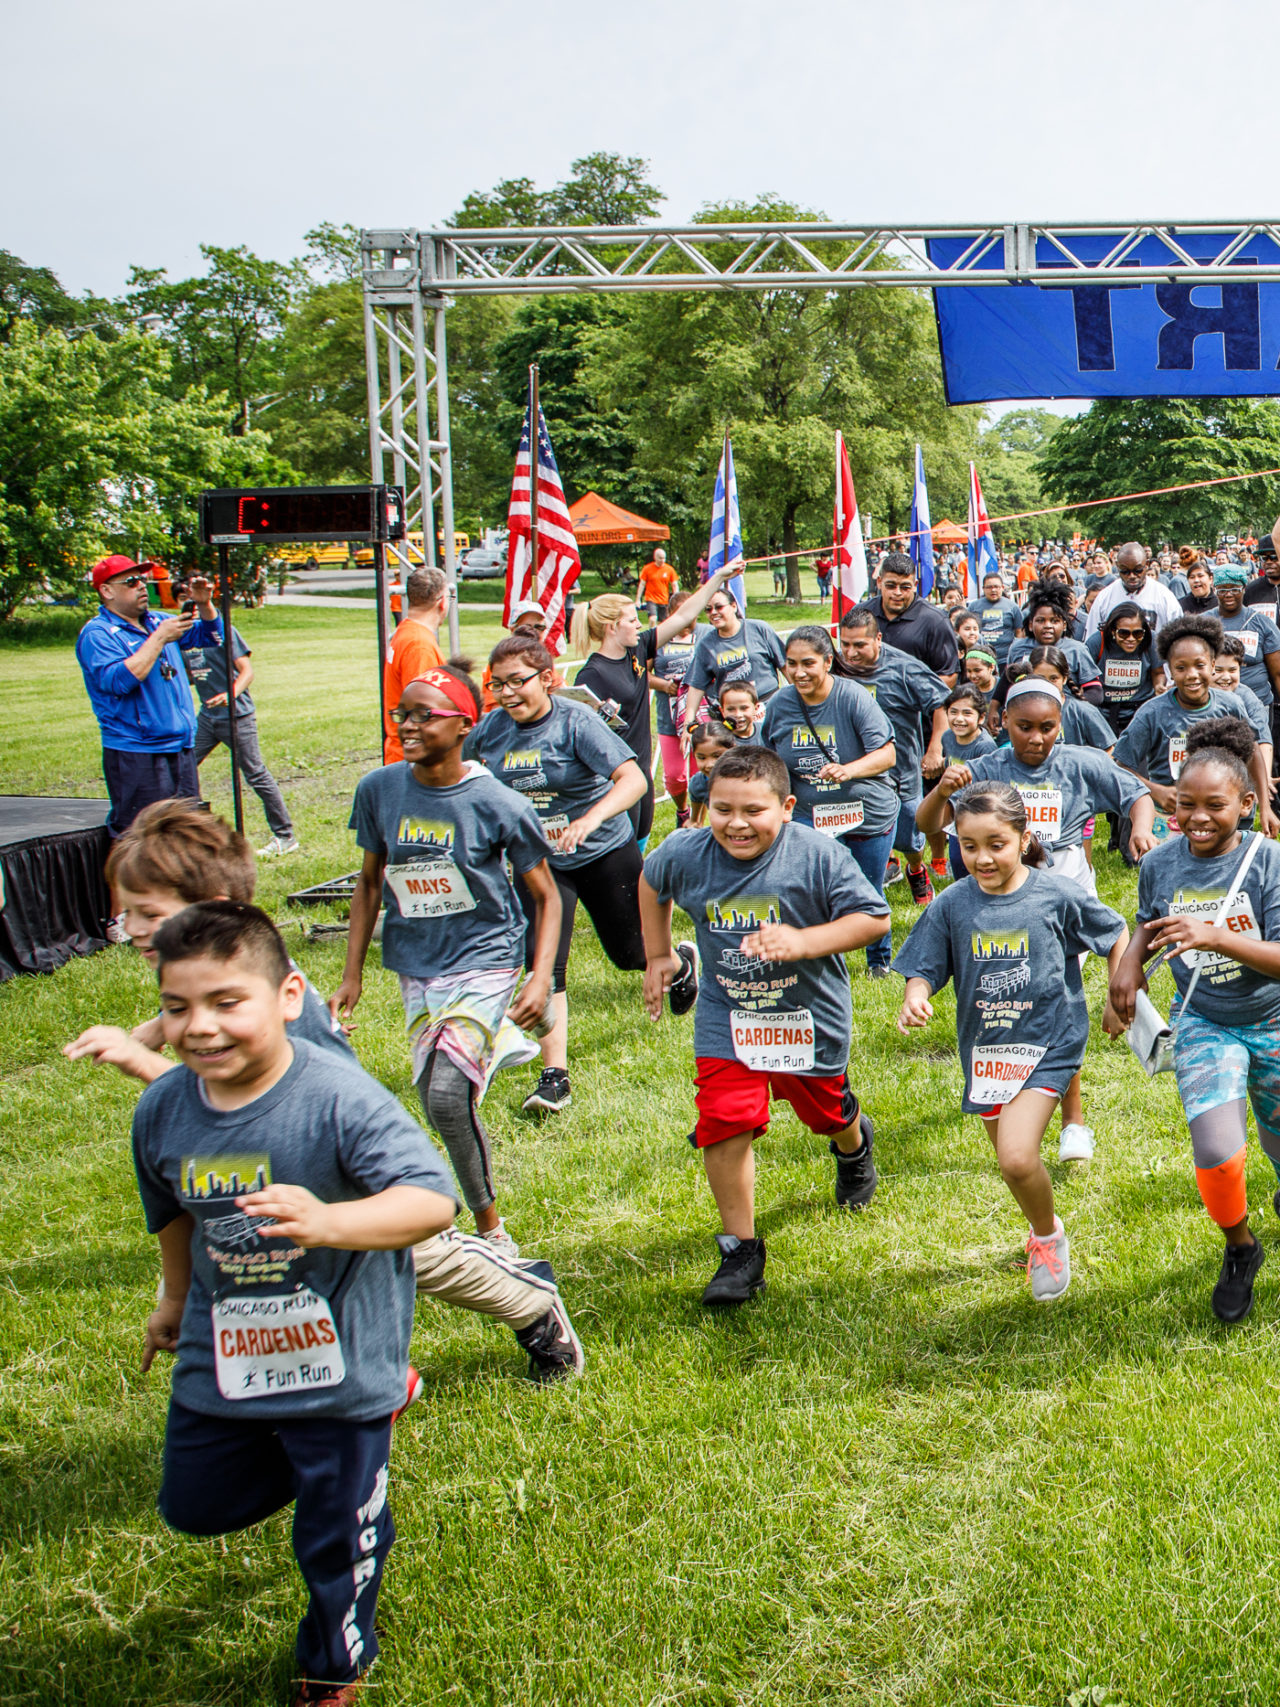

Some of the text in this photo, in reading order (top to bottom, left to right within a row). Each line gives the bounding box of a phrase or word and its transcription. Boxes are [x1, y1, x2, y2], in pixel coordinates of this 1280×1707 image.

[574, 531, 622, 543] RUN.ORG
[1107, 668, 1139, 677] BEIDLER
[815, 811, 863, 828] CARDENAS
[1024, 806, 1058, 822] DLER
[1036, 830, 1052, 841] Run
[389, 862, 454, 875] CHICAGO RUN
[405, 878, 452, 895] MAYS
[423, 901, 467, 914] Fun Run
[1173, 896, 1244, 914] CHICAGO UN
[716, 974, 798, 991] CHICAGO RUN
[1013, 1001, 1033, 1011] RUN
[737, 1012, 808, 1021] CHICAGO RUN
[735, 1028, 813, 1046] CARDENAS
[978, 1047, 1045, 1058] CHICAGO RUN
[762, 1055, 805, 1068] Fun Run
[974, 1061, 1034, 1081] CARDENAS
[217, 1294, 319, 1316] CHICAGO RUN
[220, 1317, 336, 1358] CARDENAS
[265, 1364, 332, 1388] Fun Run
